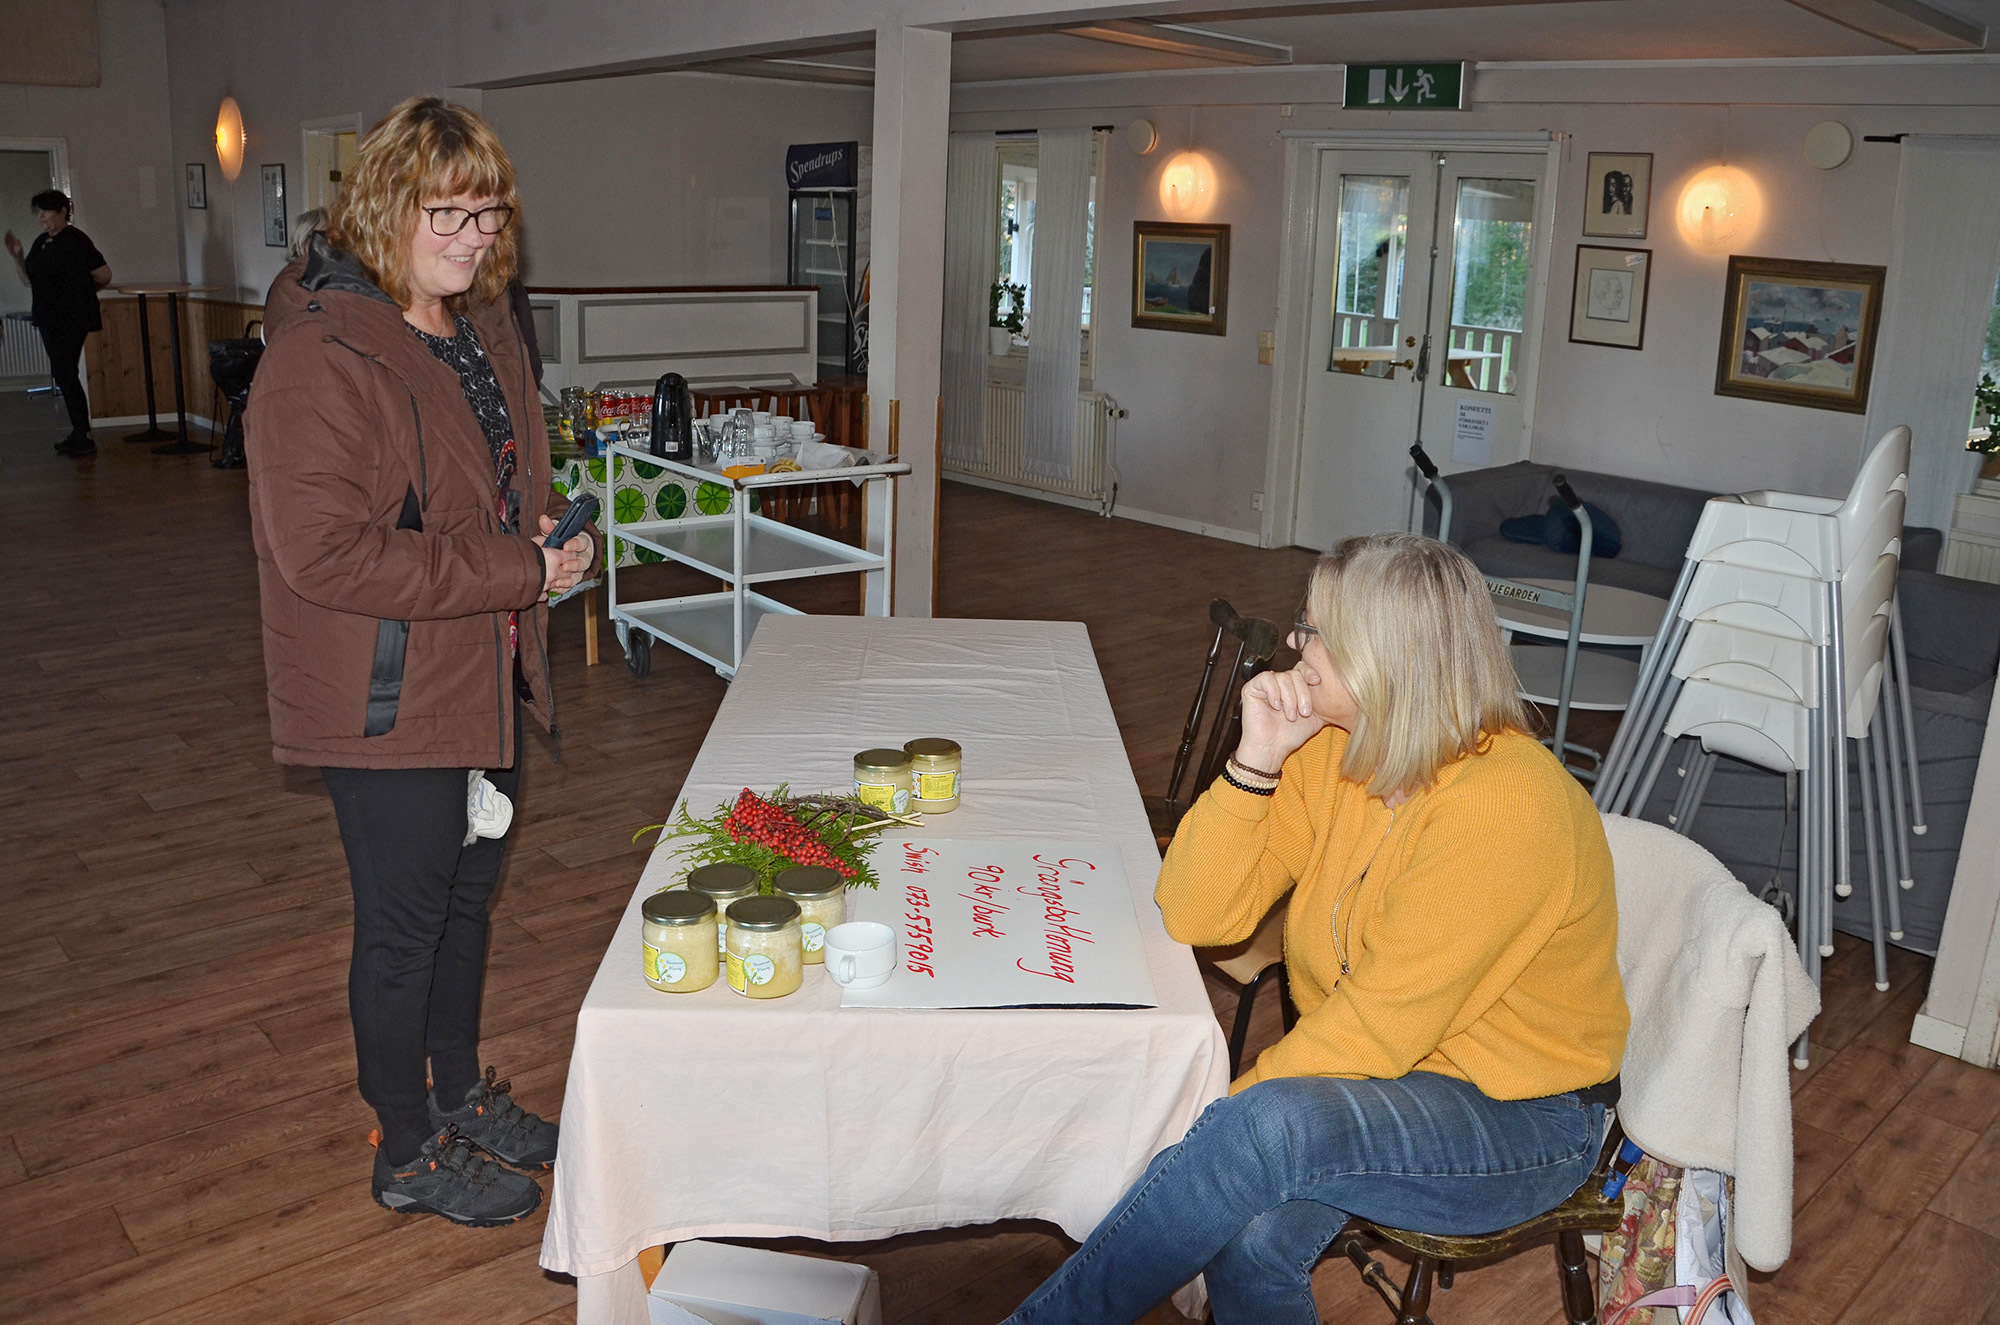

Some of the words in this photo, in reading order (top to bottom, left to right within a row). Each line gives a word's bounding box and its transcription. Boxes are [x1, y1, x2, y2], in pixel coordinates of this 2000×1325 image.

[790, 148, 844, 184] Spendrups
[1460, 405, 1491, 414] KONFETTI
[1485, 580, 1541, 602] NJEGARDEN
[900, 842, 940, 874] Swish
[904, 884, 935, 979] 073-5759015
